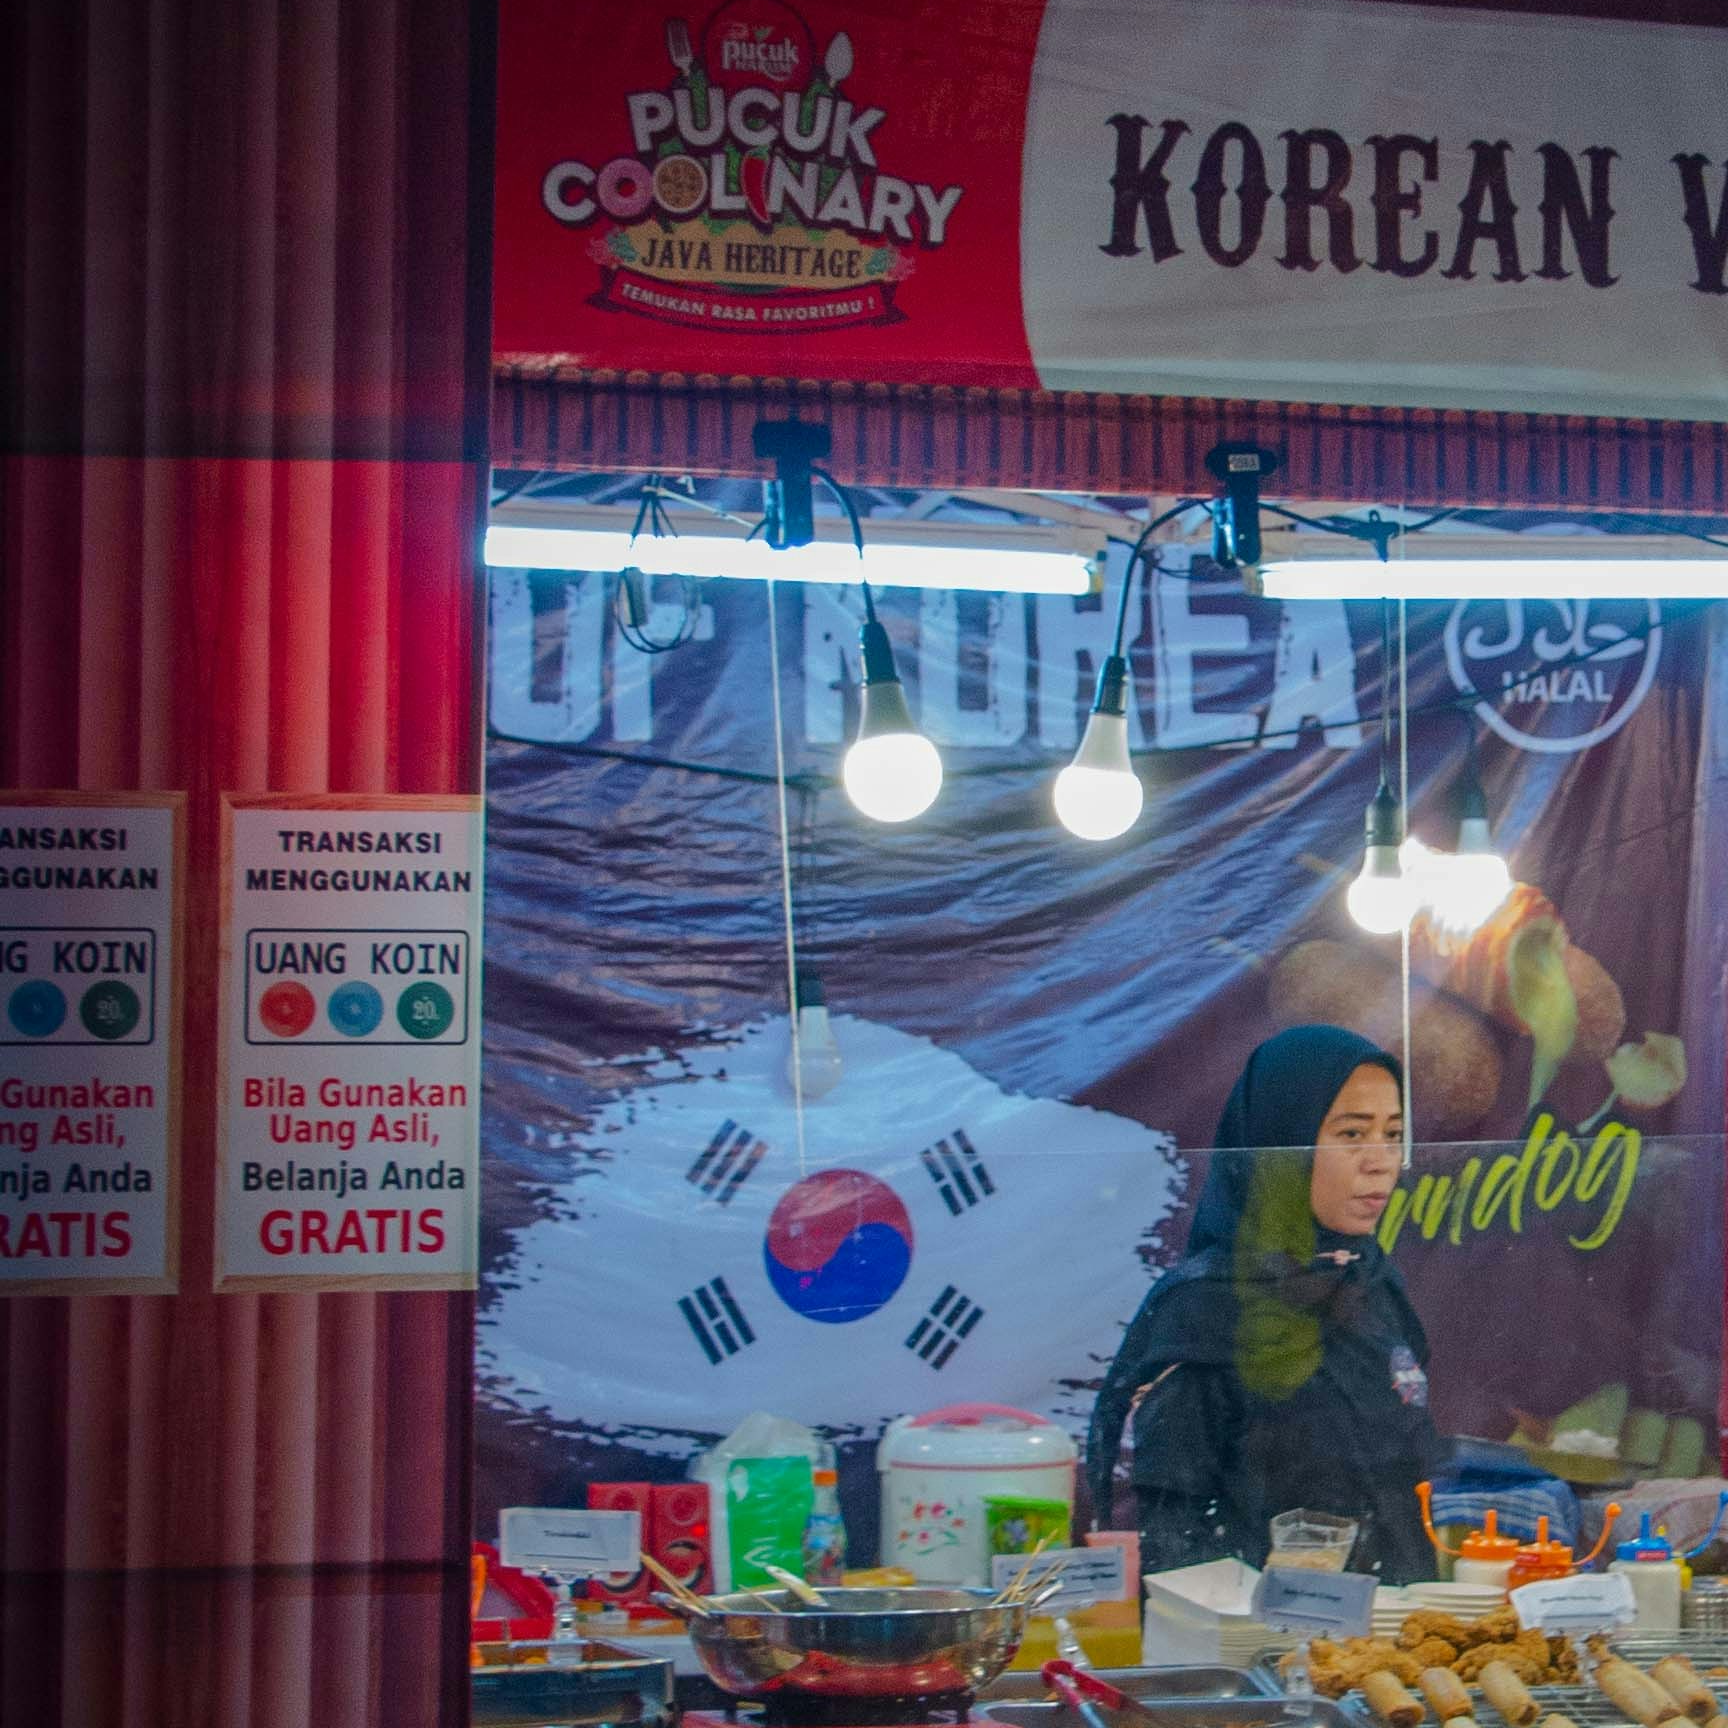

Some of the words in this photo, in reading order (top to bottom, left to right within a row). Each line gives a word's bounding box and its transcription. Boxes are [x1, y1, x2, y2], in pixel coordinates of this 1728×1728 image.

[626, 86, 887, 169] PUCUK
[1098, 112, 1623, 289] KOREAN
[641, 236, 712, 273] JAVA
[725, 241, 861, 280] HERITAGE
[621, 282, 705, 316] TEMUKAN
[711, 304, 756, 322] RASA
[763, 301, 863, 321] FAVORITMU
[1503, 670, 1613, 703] HALAL
[279, 831, 441, 854] TRANSAKSI
[246, 870, 471, 892] MENGGUNAKAN
[53, 941, 147, 974] KOIN
[255, 942, 346, 974] UANG
[371, 942, 460, 974] KOIN
[0, 1077, 155, 1109] Gunakan
[244, 1078, 305, 1108] Bila
[320, 1078, 467, 1108] Gunakan
[53, 1114, 126, 1148] Asli,
[270, 1116, 356, 1150] Uang
[369, 1114, 440, 1147] Asli,
[63, 1161, 153, 1193] Anda
[243, 1161, 367, 1198] Belanja
[380, 1161, 466, 1191] Anda
[260, 1209, 446, 1256] GRATIS
